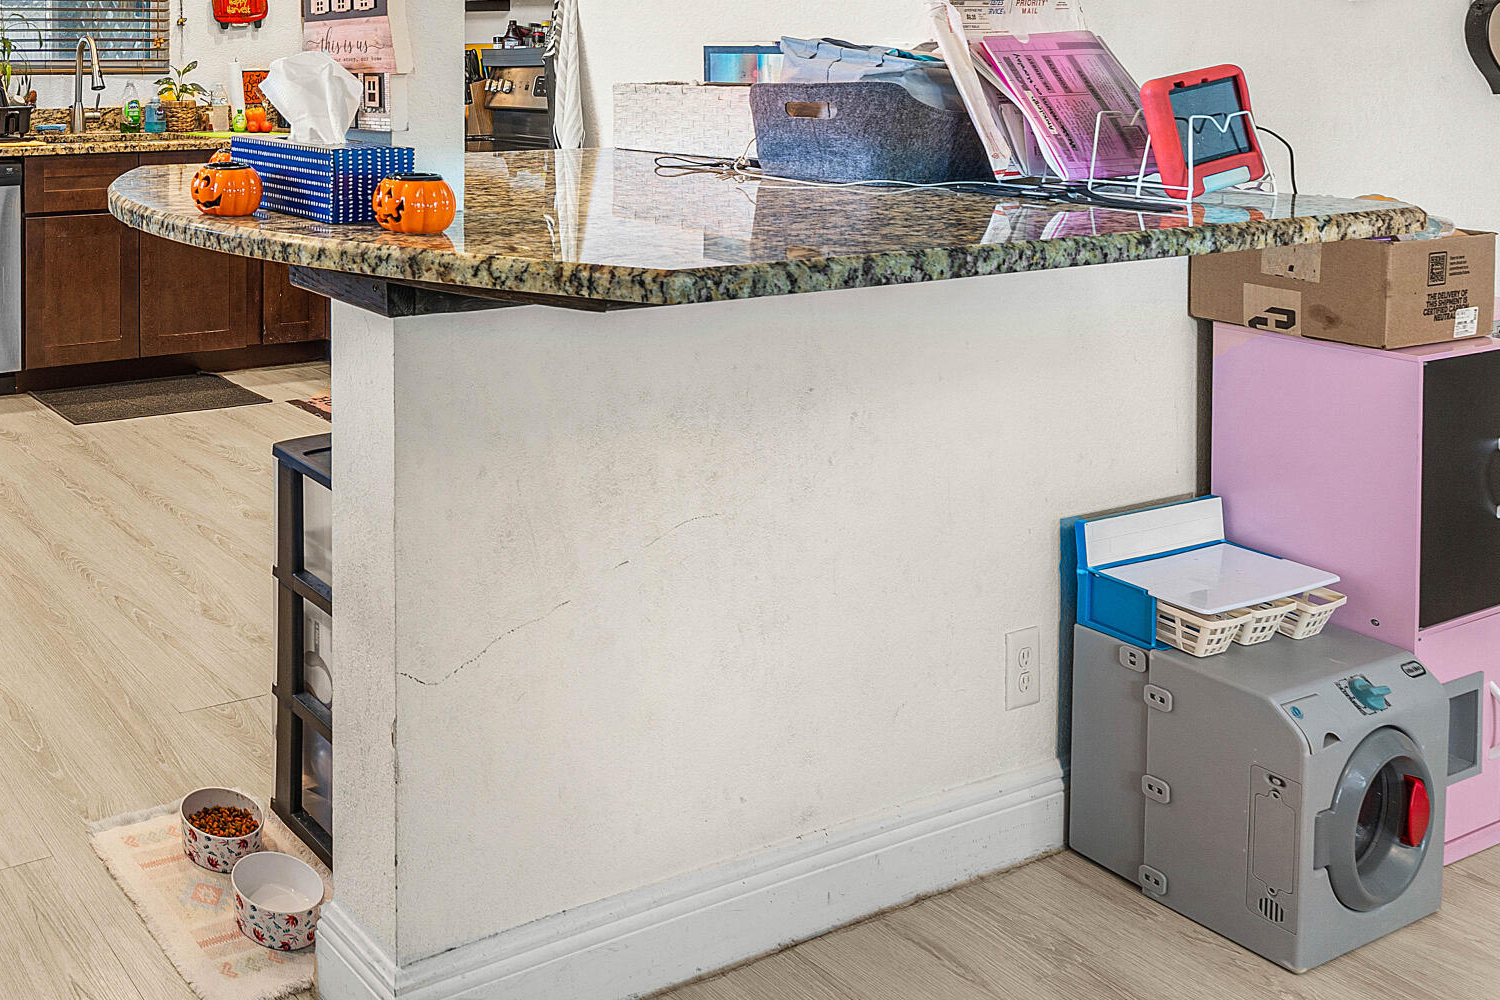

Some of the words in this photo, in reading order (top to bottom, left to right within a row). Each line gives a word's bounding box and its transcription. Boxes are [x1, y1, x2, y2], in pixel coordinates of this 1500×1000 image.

[227, 5, 251, 14] Harvest
[318, 26, 340, 54] this
[343, 39, 352, 54] is
[356, 39, 368, 54] us
[1012, 53, 1033, 84] Monday
[1427, 293, 1437, 301] THE
[1438, 290, 1460, 299] DELIVERY
[1438, 297, 1462, 306] SHIPMENT
[1423, 306, 1448, 316] CERTIFIED
